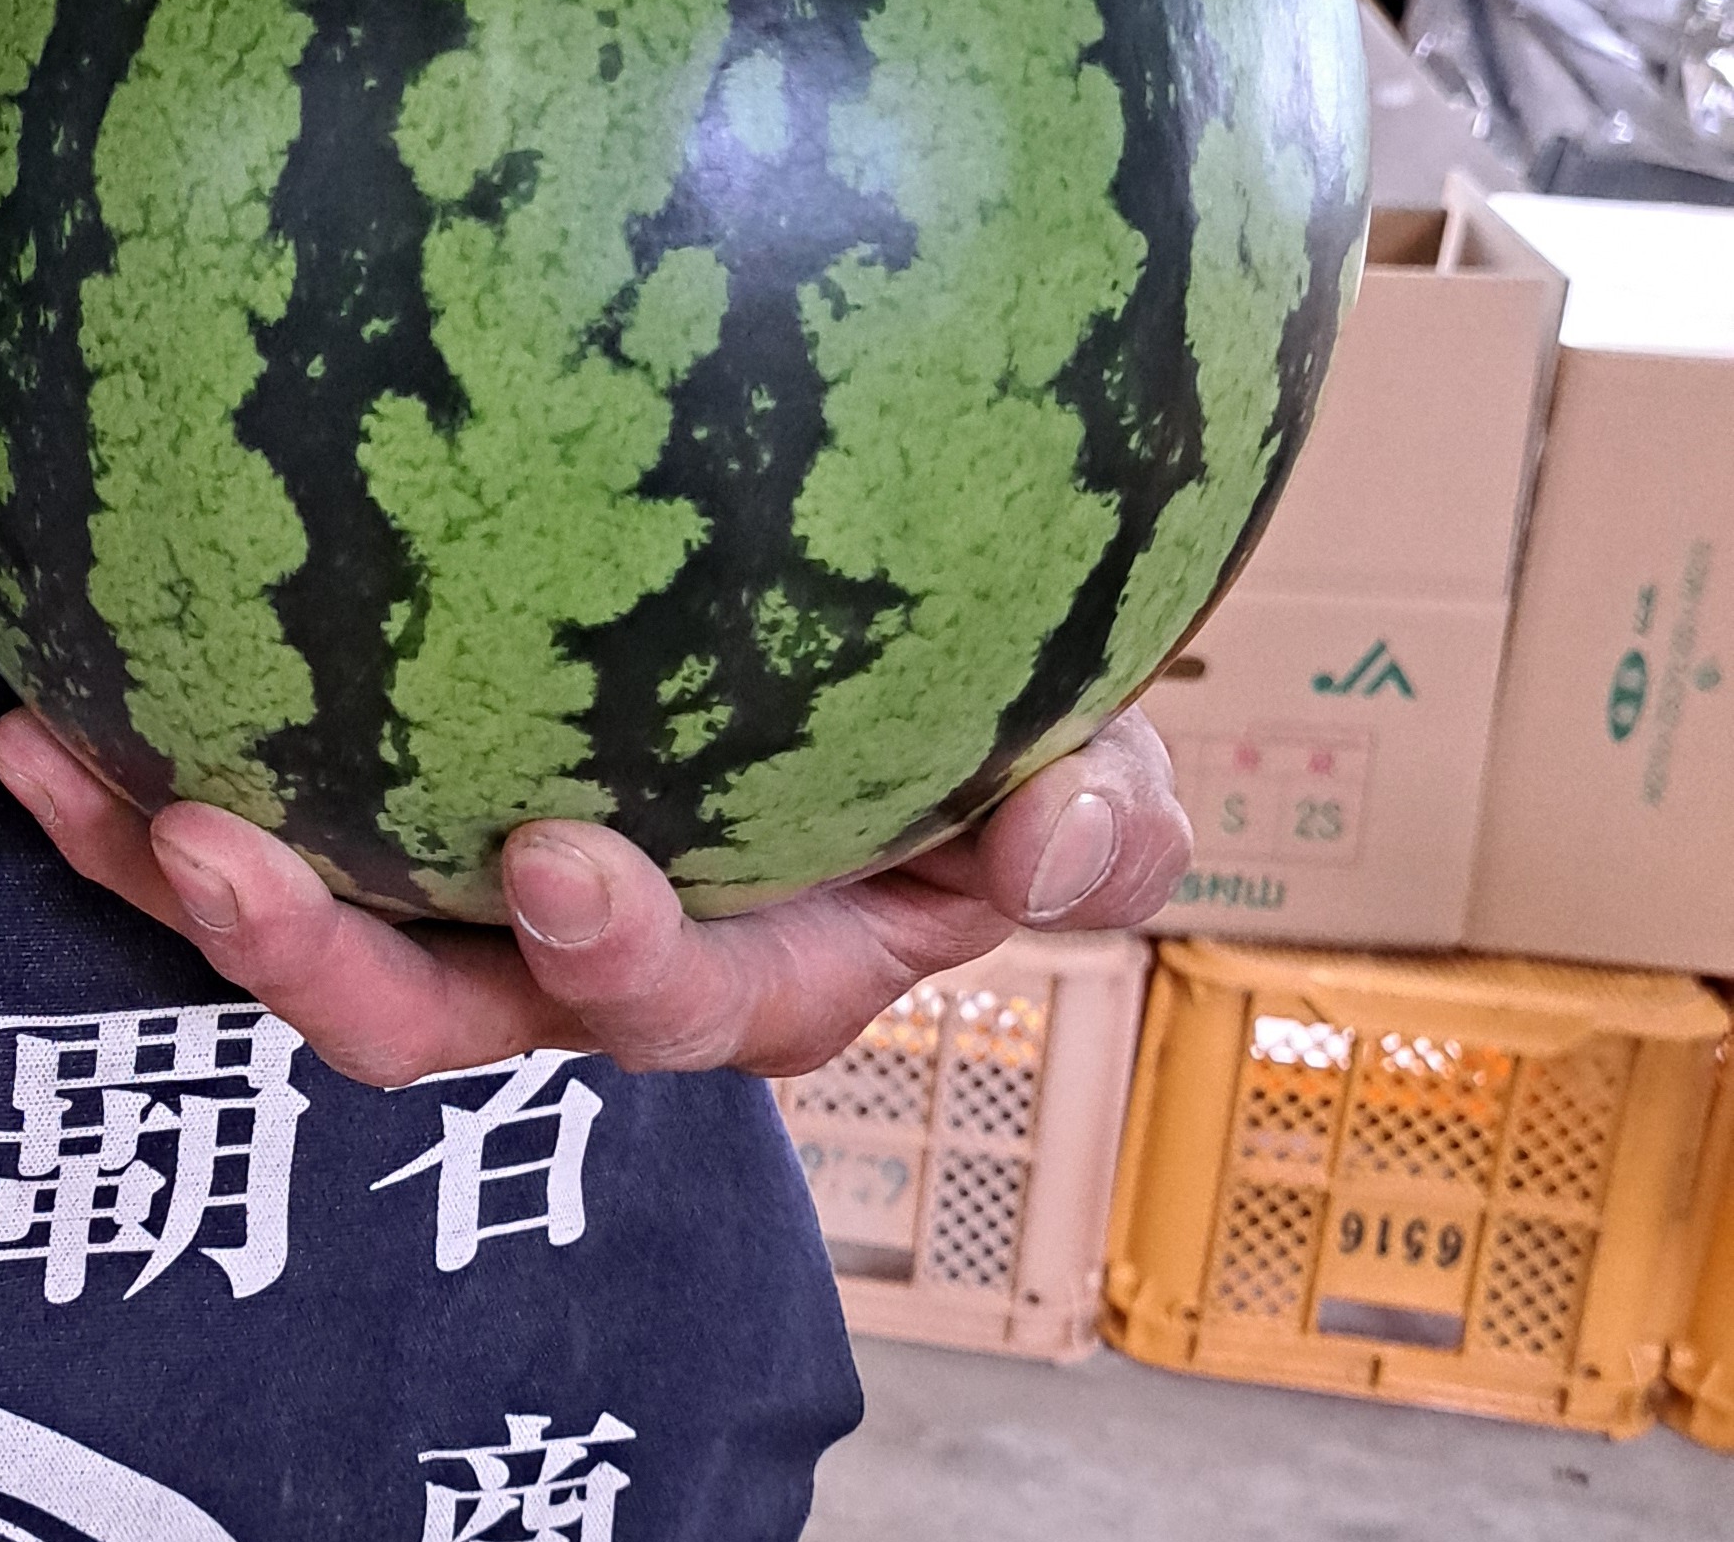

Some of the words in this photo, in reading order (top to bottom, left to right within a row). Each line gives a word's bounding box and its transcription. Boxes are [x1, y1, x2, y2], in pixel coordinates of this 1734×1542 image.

[1220, 793, 1247, 835] S
[1294, 797, 1343, 842] 2S
[1340, 1211, 1463, 1270] 6516
